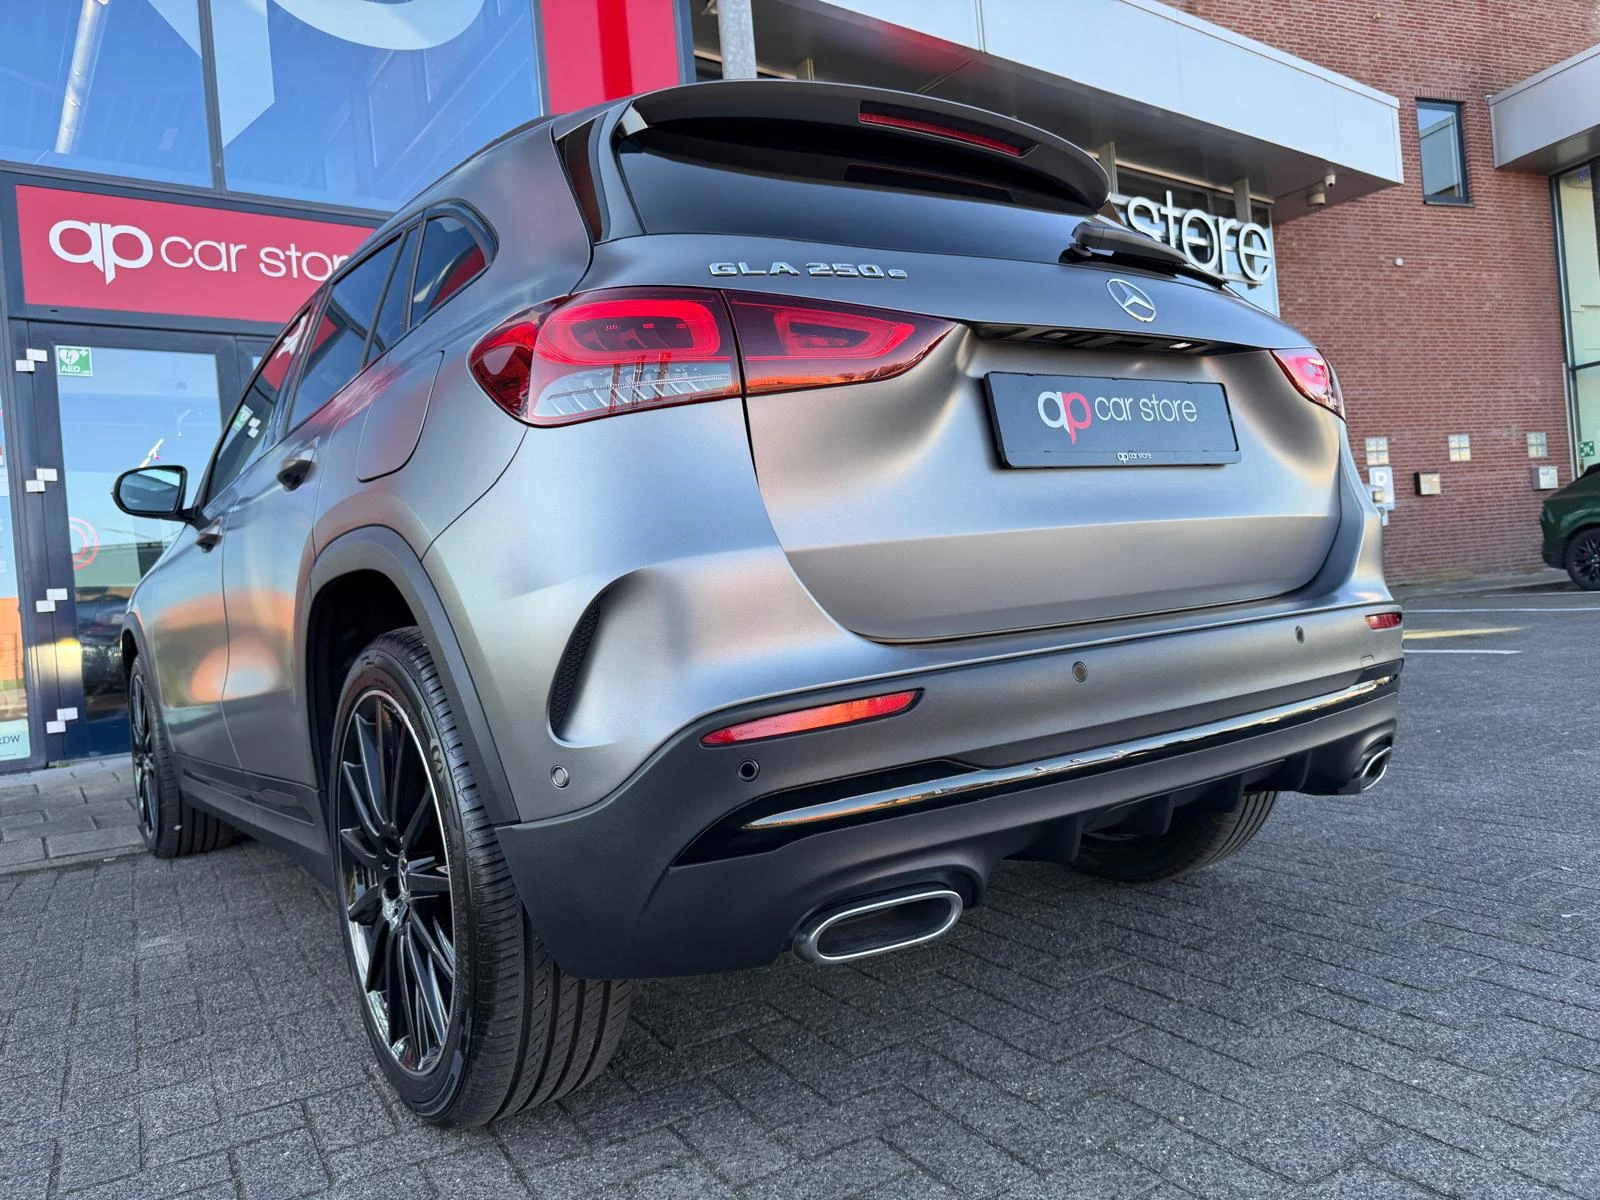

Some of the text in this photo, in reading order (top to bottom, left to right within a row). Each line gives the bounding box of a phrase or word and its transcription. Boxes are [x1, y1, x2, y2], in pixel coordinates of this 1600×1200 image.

[48, 219, 350, 286] ap car stor
[1128, 190, 1273, 282] store
[708, 261, 801, 276] GLA
[61, 364, 81, 374] AED
[1037, 391, 1198, 446] ap car store
